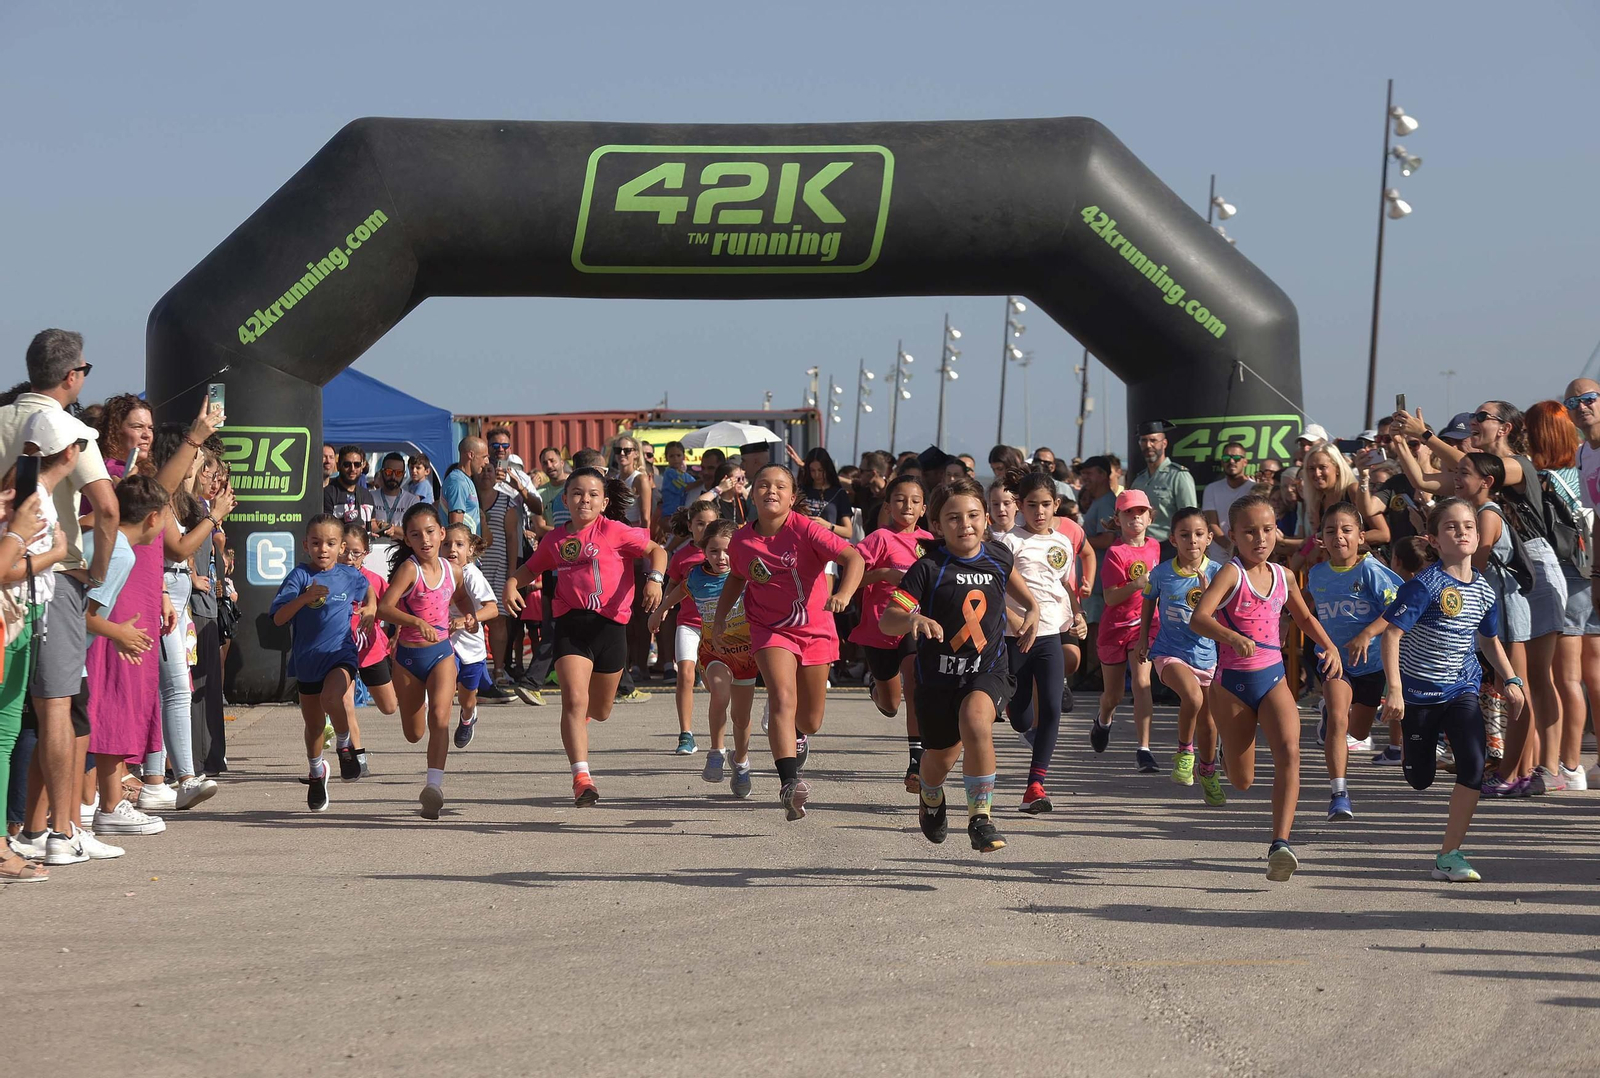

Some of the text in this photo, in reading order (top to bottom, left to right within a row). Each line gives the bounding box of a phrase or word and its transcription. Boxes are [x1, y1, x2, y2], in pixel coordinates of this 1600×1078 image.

[615, 161, 854, 225] 42K
[711, 225, 842, 262] running
[237, 209, 389, 345] 42krunning.com
[1080, 205, 1227, 339] 42krunning.com
[220, 437, 296, 472] 2K
[1171, 425, 1292, 463] 42K
[230, 471, 291, 493] unning
[223, 510, 302, 525] running.com
[956, 573, 994, 585] STOP
[1165, 605, 1193, 625] EV
[1317, 600, 1371, 620] EVOS
